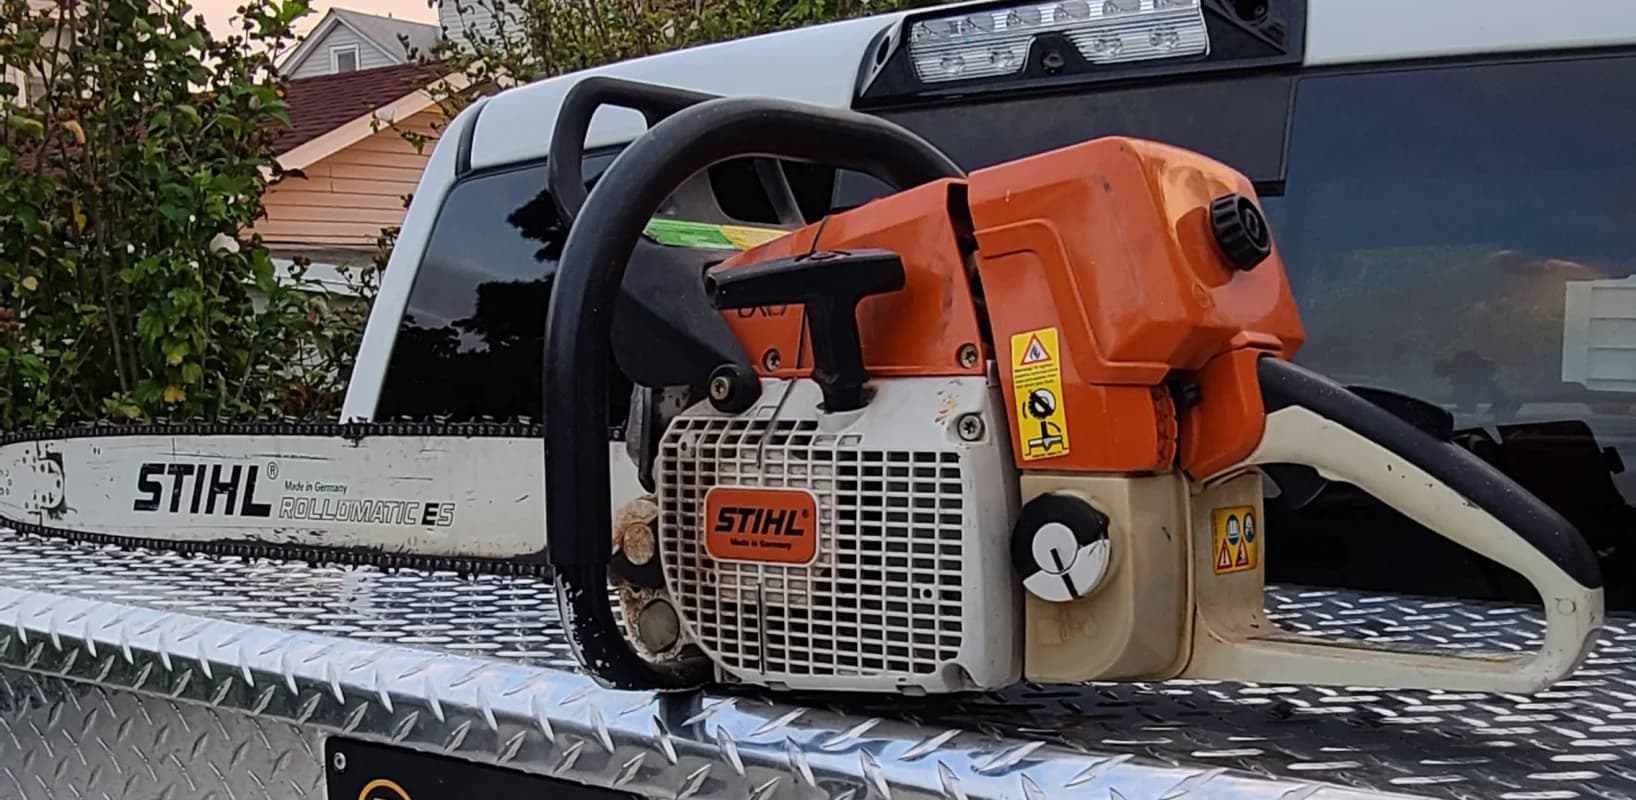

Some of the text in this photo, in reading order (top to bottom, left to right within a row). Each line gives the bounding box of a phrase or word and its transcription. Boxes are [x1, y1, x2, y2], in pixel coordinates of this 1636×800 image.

[284, 480, 348, 495] Made in Germany
[279, 497, 456, 527] ROLLOMATIC ES
